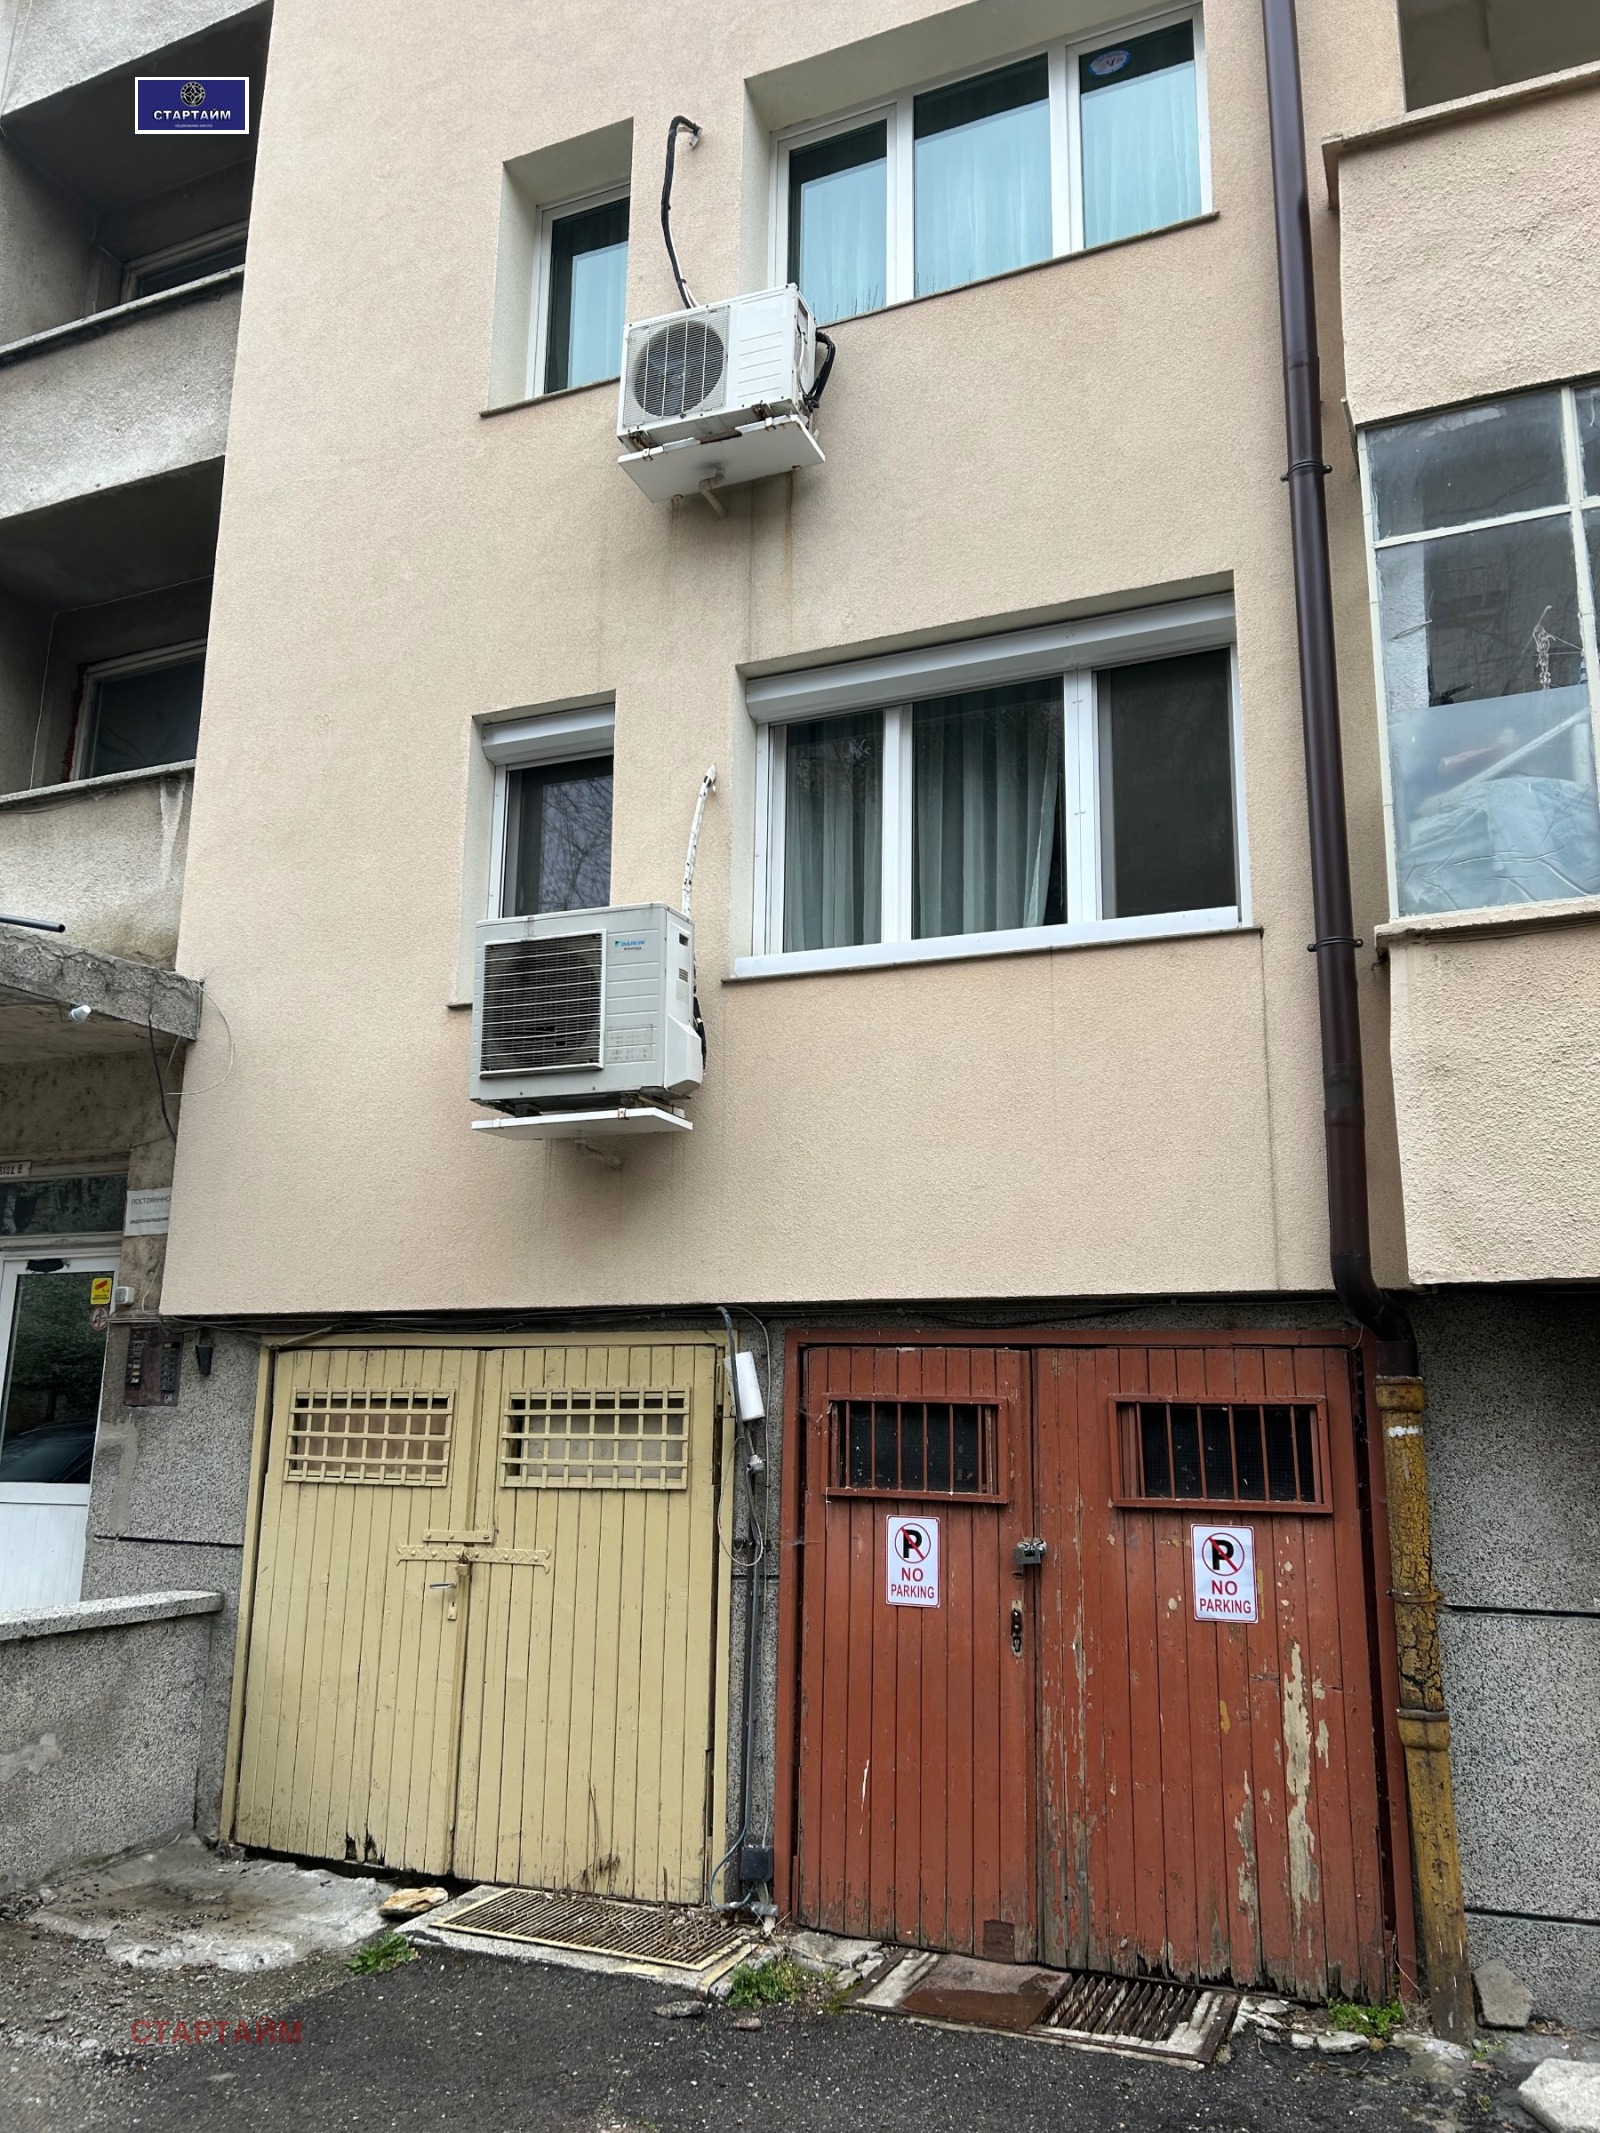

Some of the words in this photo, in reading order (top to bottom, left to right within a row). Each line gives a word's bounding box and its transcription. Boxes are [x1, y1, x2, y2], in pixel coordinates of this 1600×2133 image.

[901, 1567, 924, 1582] NO
[891, 1584, 935, 1599] PARKING
[1211, 1580, 1238, 1596] NO
[1199, 1598, 1251, 1614] PARKING
